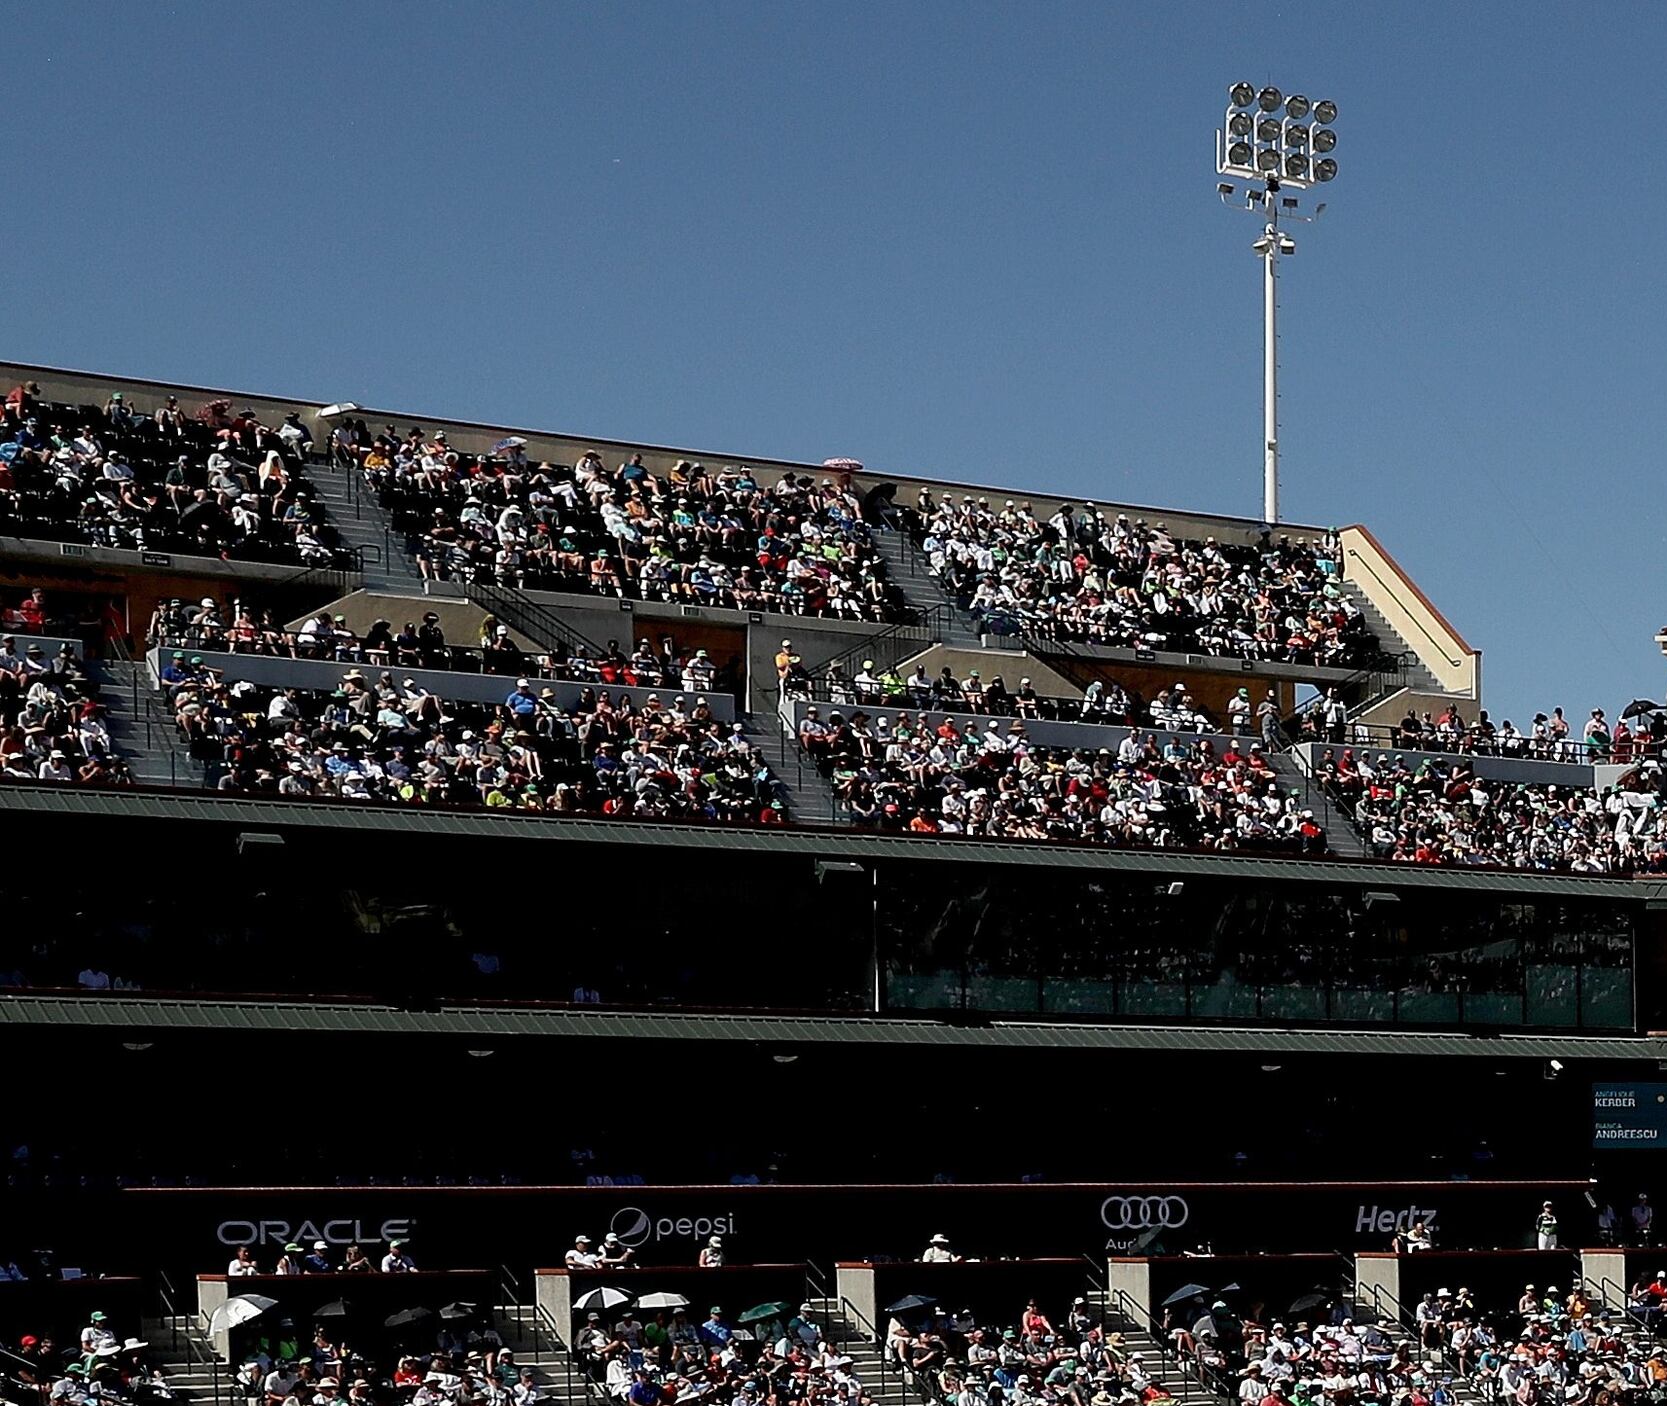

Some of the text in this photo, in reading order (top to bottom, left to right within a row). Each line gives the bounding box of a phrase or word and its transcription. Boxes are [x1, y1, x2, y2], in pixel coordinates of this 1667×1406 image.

[1595, 1098, 1636, 1107] KERBER
[1595, 1129, 1658, 1139] ANDREESCU
[217, 1219, 410, 1246] ORACLE
[655, 1213, 735, 1239] pepsi
